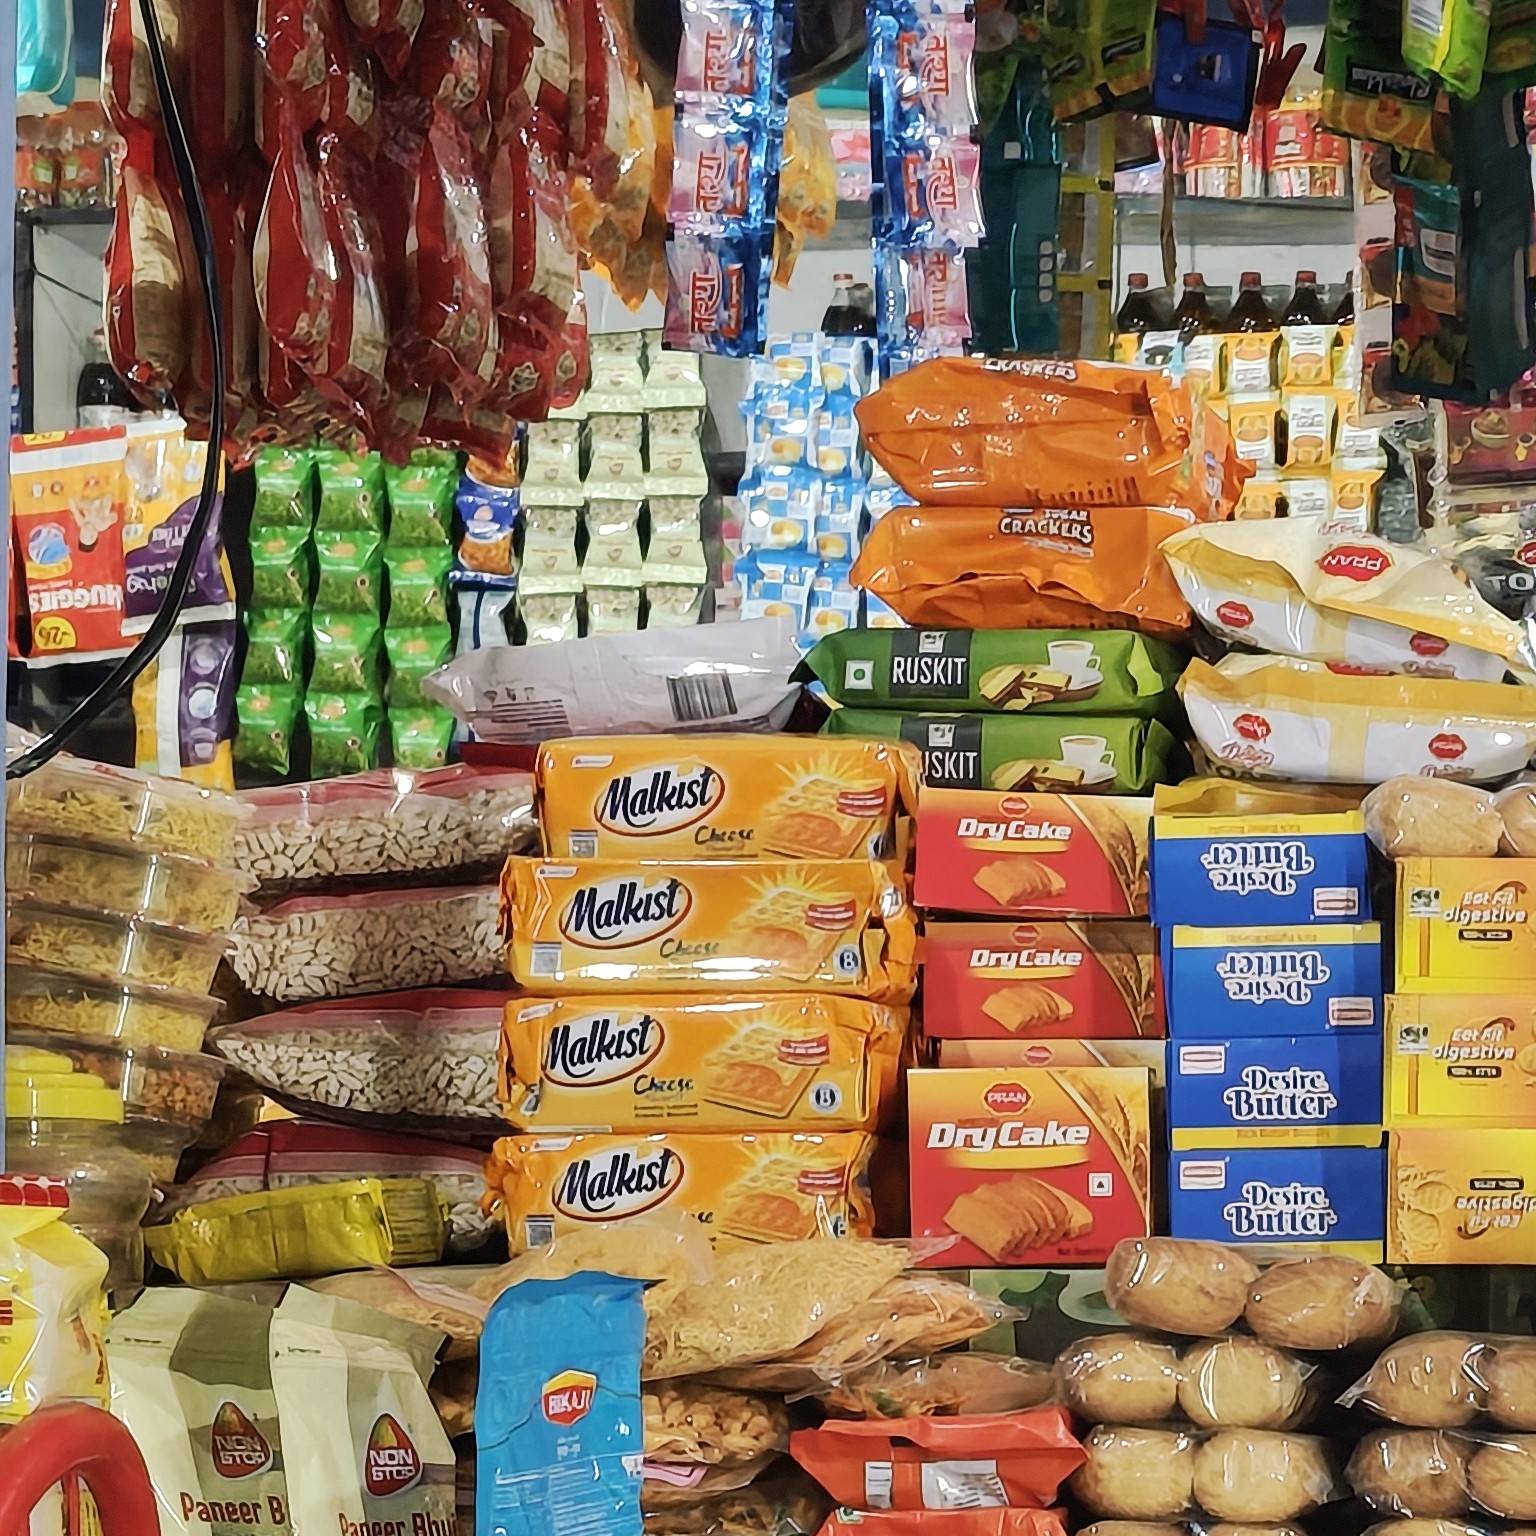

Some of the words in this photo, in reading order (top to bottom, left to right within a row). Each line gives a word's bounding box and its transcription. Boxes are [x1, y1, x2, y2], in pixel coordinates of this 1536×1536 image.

[1000, 516, 1093, 543] CRACKERS
[1321, 554, 1386, 572] PRAN
[28, 583, 124, 613] HUGGIES
[891, 656, 967, 687] RUSKIT
[924, 750, 979, 780] USKIT
[599, 764, 716, 829] Malkist
[694, 825, 755, 846] Cheese
[1200, 841, 1315, 875] Butter
[1209, 868, 1298, 896] Desire
[565, 877, 683, 941] Malkist
[1443, 907, 1528, 926] digestive
[660, 938, 720, 960] Cheese
[1215, 950, 1331, 984] Butter
[1224, 978, 1312, 1005] Desire
[548, 1014, 657, 1079] Malkist
[1431, 1044, 1516, 1063] digestive
[633, 1075, 695, 1097] Cheese
[1242, 1065, 1330, 1091] Desire
[986, 1091, 1028, 1105] PRAN
[1223, 1086, 1338, 1121] Butter
[562, 1146, 675, 1213] Malkist
[1242, 1181, 1330, 1207] Desire
[1223, 1201, 1338, 1237] Butter
[369, 1449, 413, 1466] NON
[371, 1465, 415, 1481] STOP
[179, 1491, 262, 1525] Paneer
